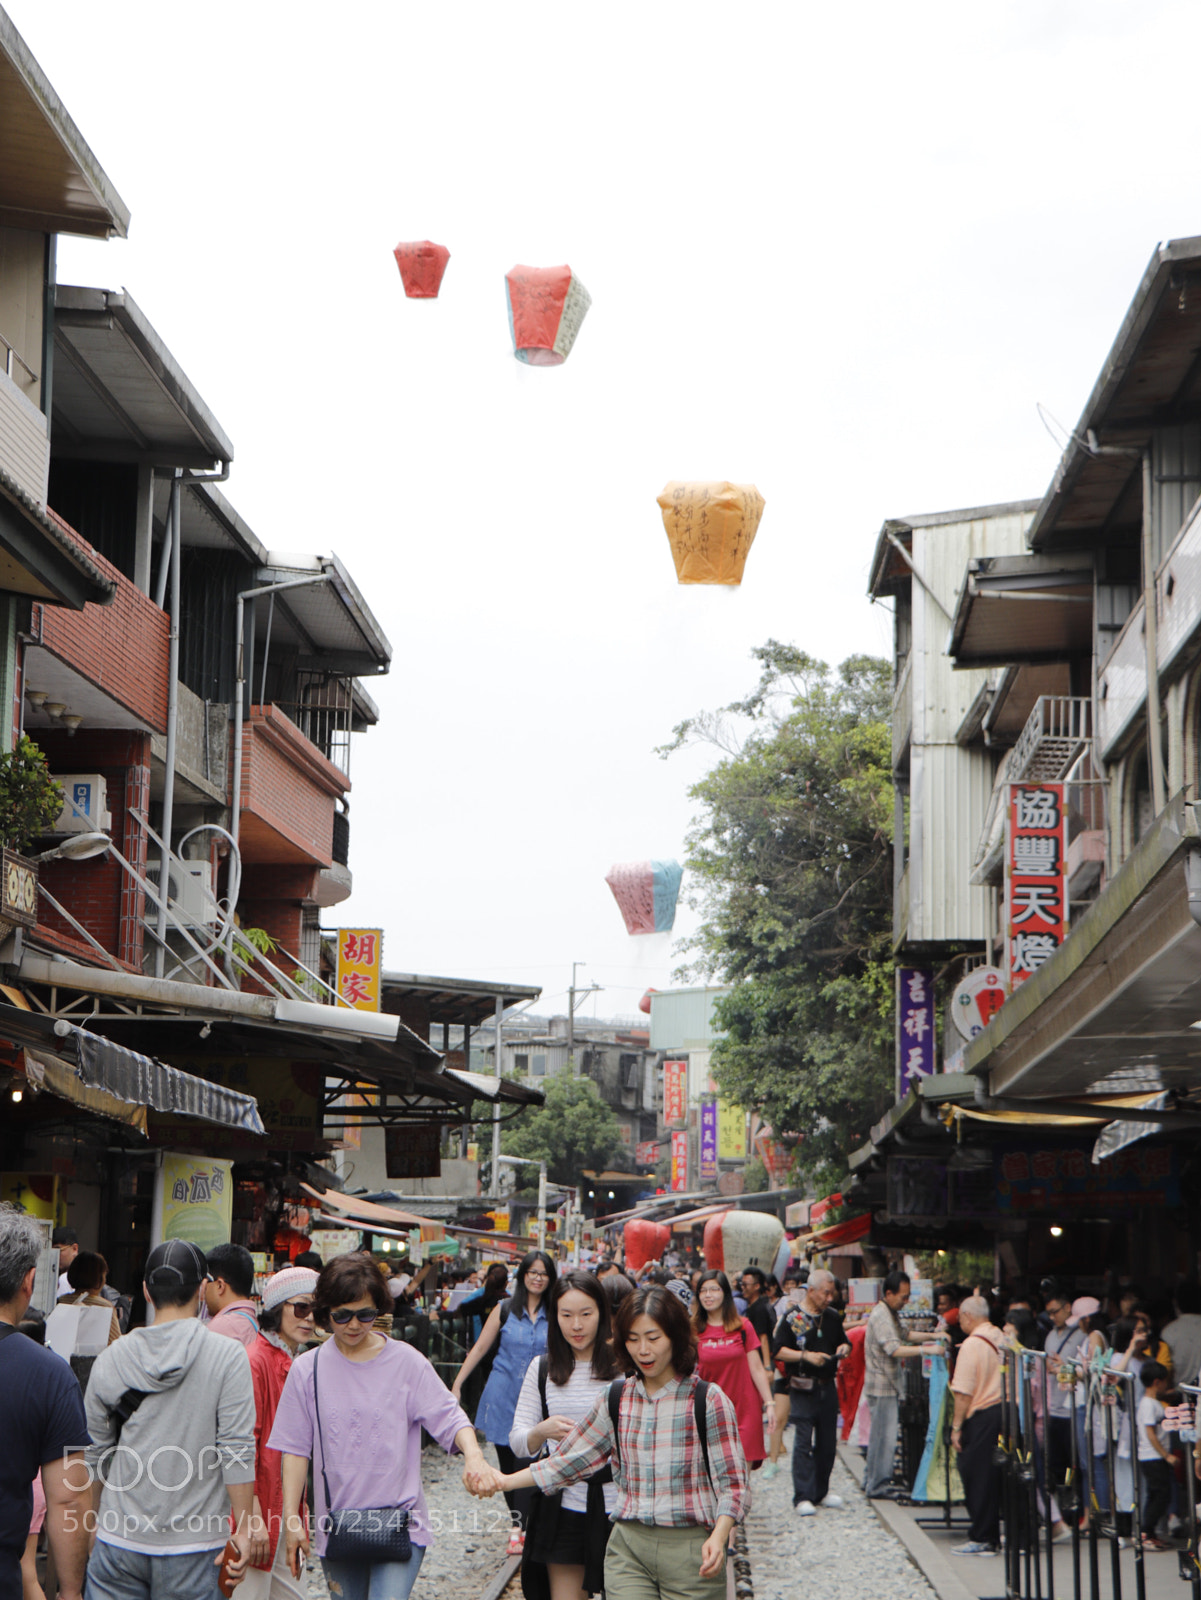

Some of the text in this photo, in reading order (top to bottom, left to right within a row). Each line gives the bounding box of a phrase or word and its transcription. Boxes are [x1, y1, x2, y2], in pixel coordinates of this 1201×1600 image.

[1012, 787, 1060, 973] 協豐天燈
[341, 932, 376, 1005] 胡家
[903, 971, 930, 1099] 吉祥天
